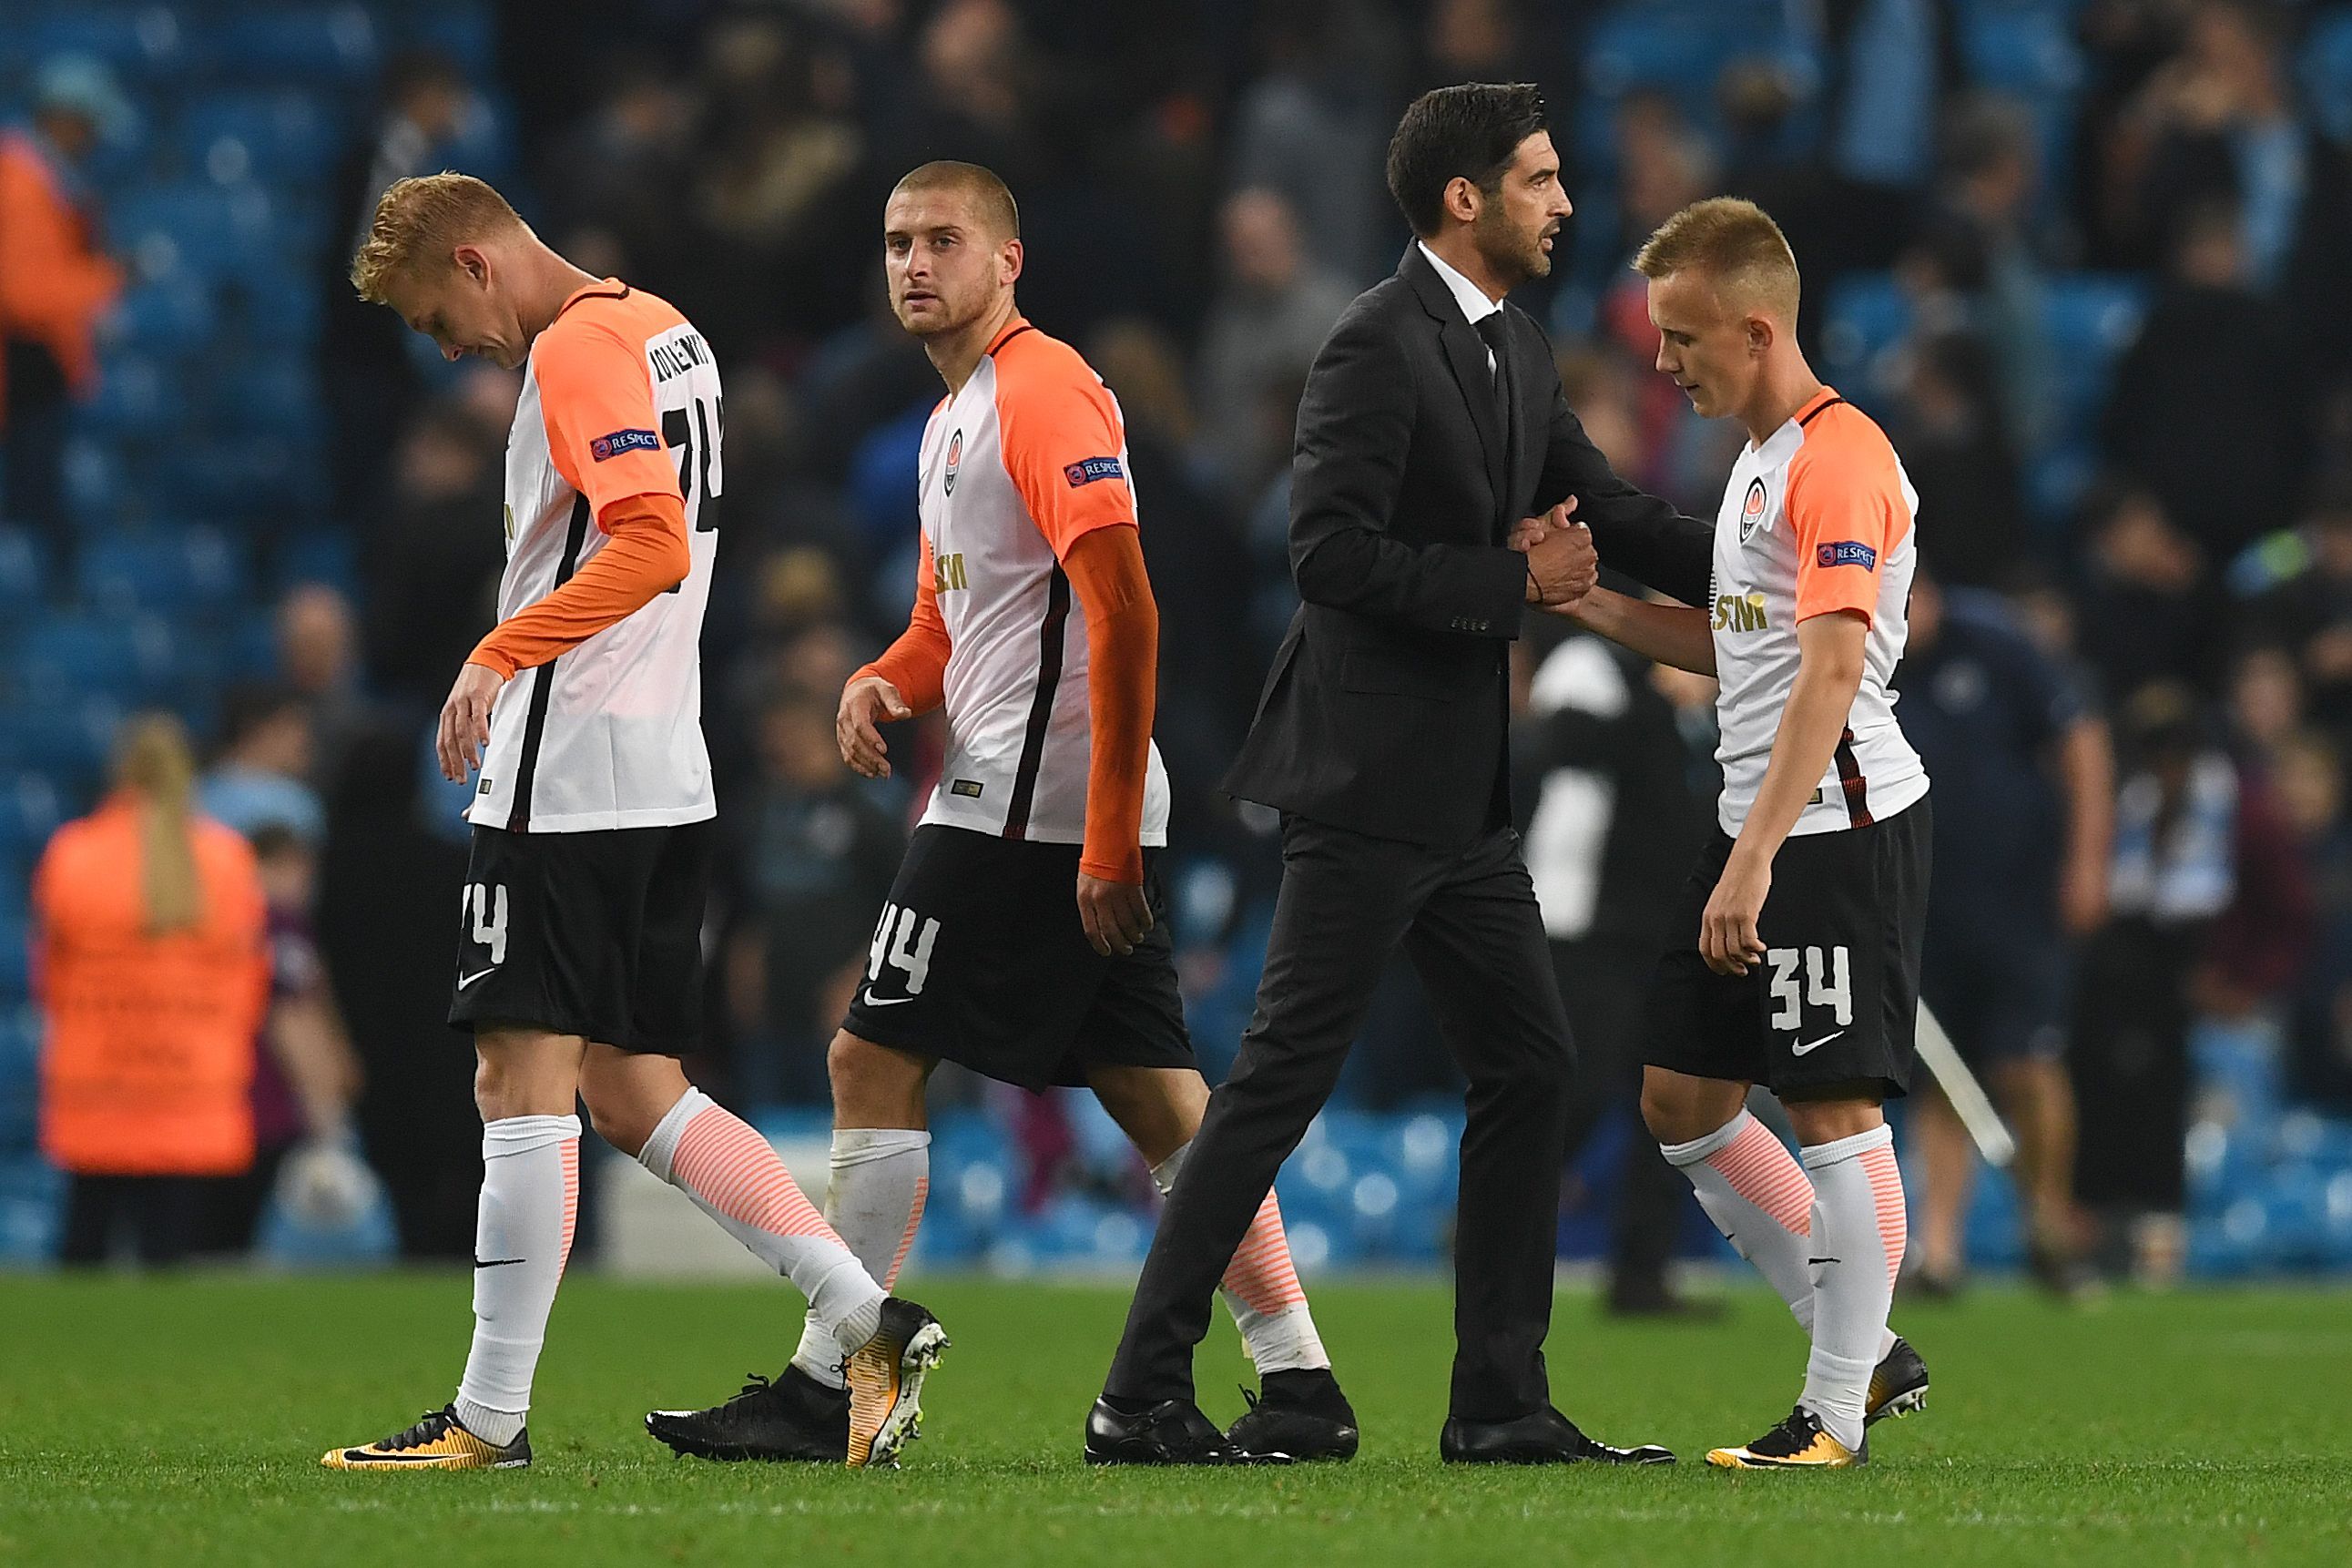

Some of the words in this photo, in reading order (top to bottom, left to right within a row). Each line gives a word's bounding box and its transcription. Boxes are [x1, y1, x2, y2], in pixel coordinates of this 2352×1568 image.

[612, 433, 657, 449] RESPECT
[1837, 547, 1875, 565] RESPECT
[869, 900, 941, 994] 44
[1767, 945, 1853, 1030] 34
